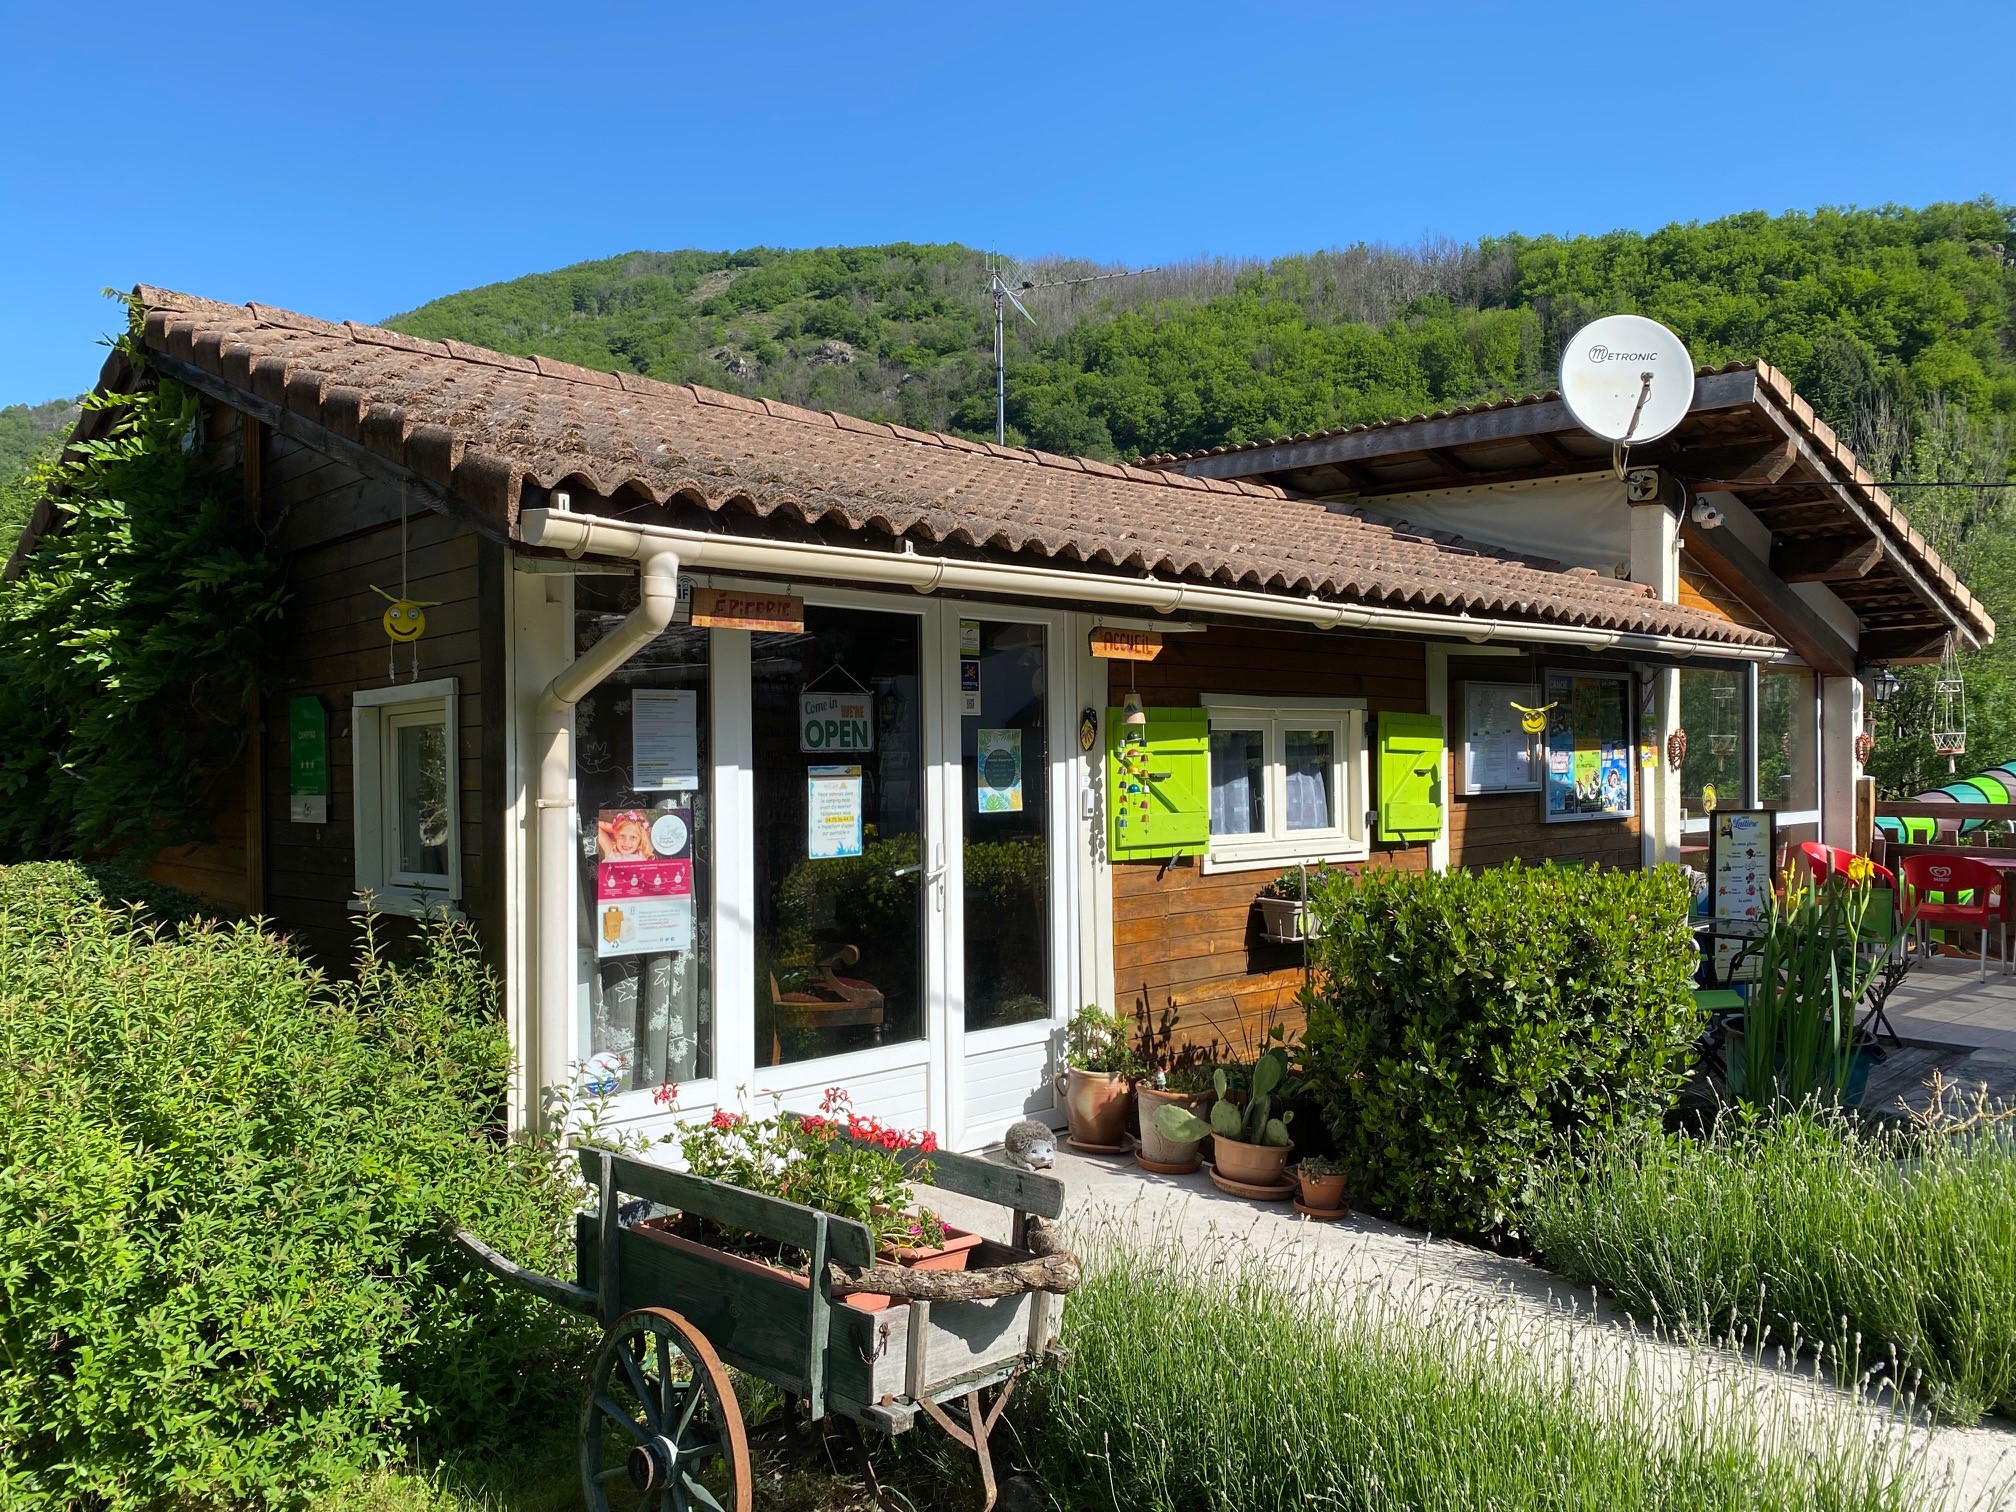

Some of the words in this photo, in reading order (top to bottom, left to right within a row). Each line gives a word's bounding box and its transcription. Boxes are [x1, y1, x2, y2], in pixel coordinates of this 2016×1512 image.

[1589, 344, 1658, 364] METRONIC
[805, 700, 828, 715] Come
[829, 697, 838, 709] in
[841, 705, 865, 719] WE'RE
[297, 730, 316, 740] CAMPING
[804, 719, 869, 748] OPEN
